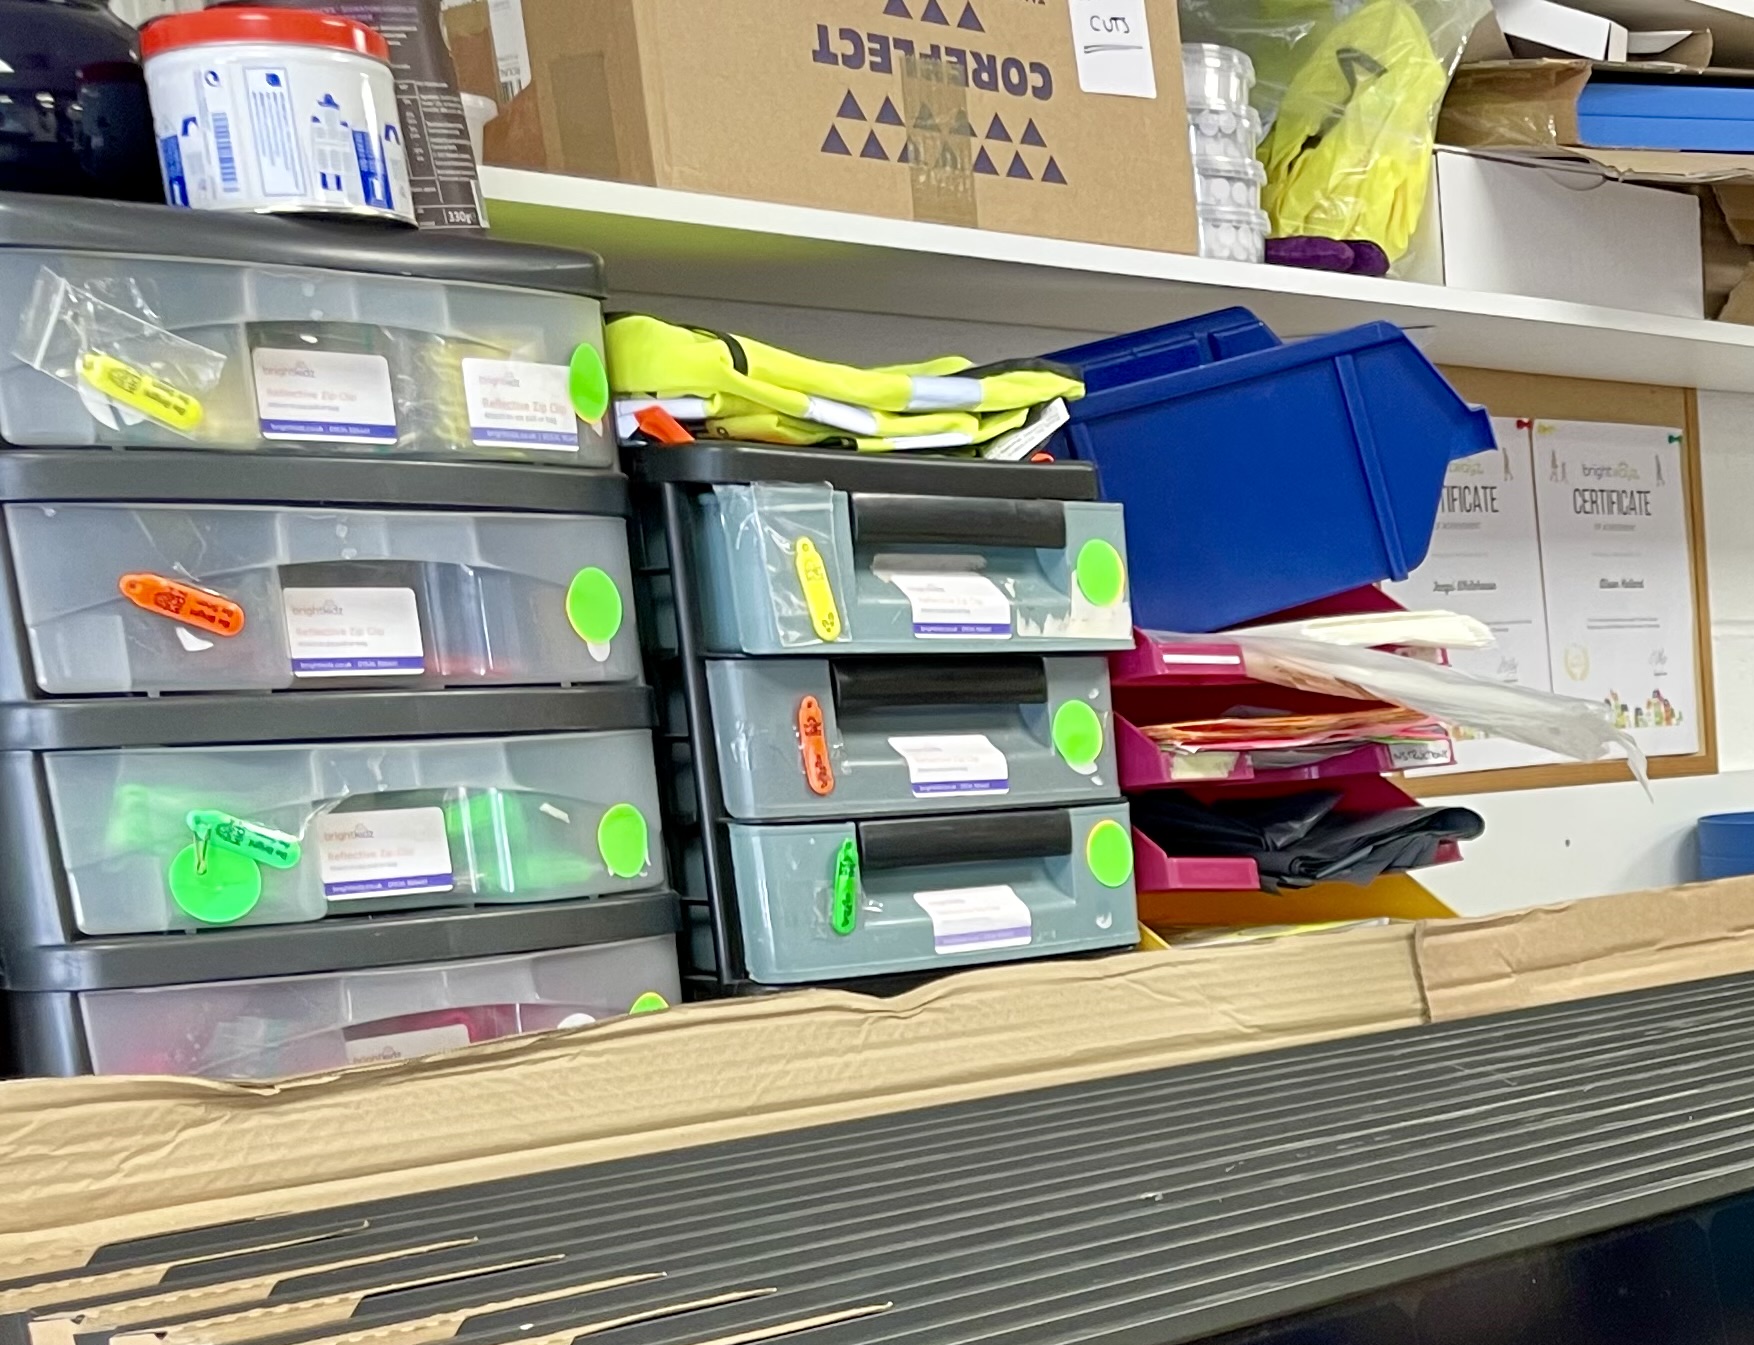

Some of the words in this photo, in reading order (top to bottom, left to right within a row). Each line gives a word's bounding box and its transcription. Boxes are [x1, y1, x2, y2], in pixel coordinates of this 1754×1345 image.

[1088, 15, 1130, 34] CUTS
[812, 24, 1054, 101] COREFLECT
[1440, 486, 1500, 513] TIFICATE
[1573, 488, 1652, 516] CERTIFICATE
